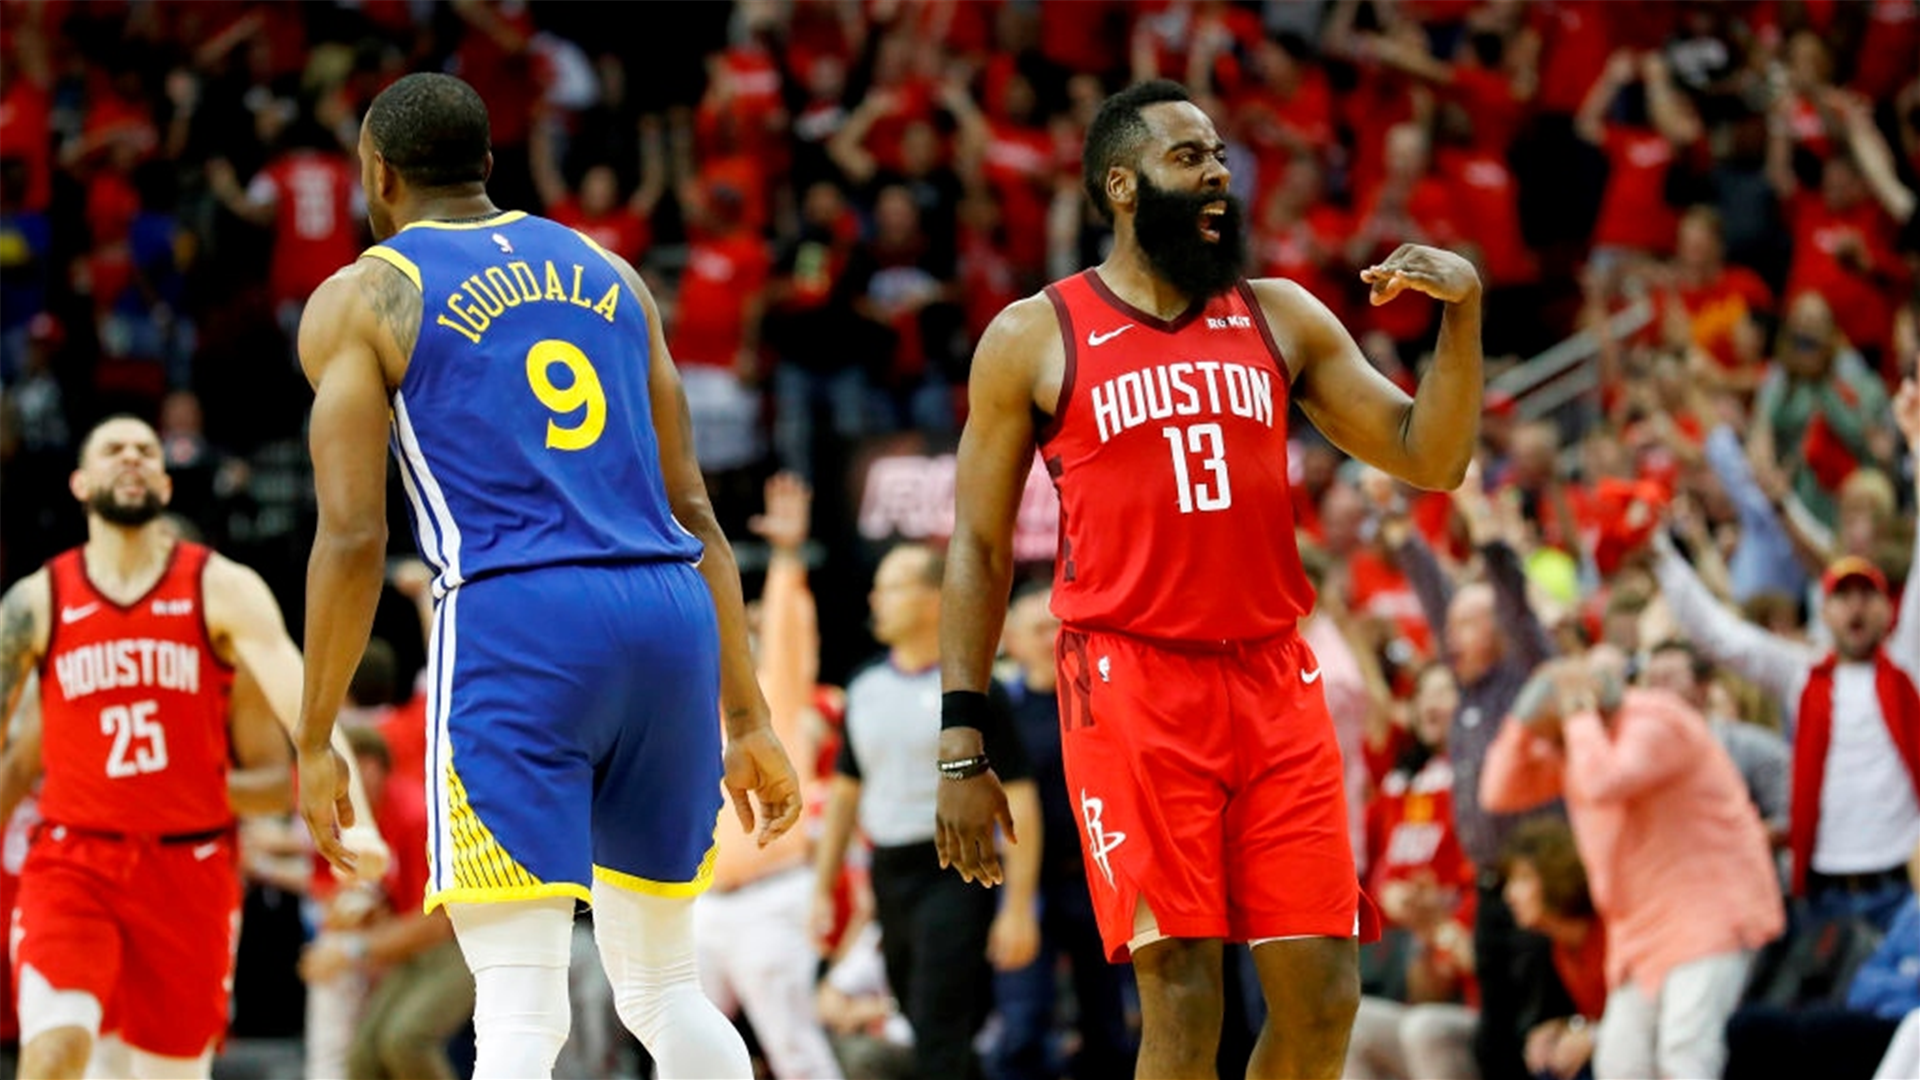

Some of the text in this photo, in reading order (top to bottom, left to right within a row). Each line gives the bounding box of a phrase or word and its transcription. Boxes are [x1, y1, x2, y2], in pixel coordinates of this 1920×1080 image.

[437, 260, 620, 344] IGUODALA
[526, 338, 607, 451] 9
[1091, 361, 1273, 444] HOUSTON
[1162, 422, 1232, 513] 13
[55, 637, 199, 701] HOUSTON
[100, 699, 169, 779] 25
